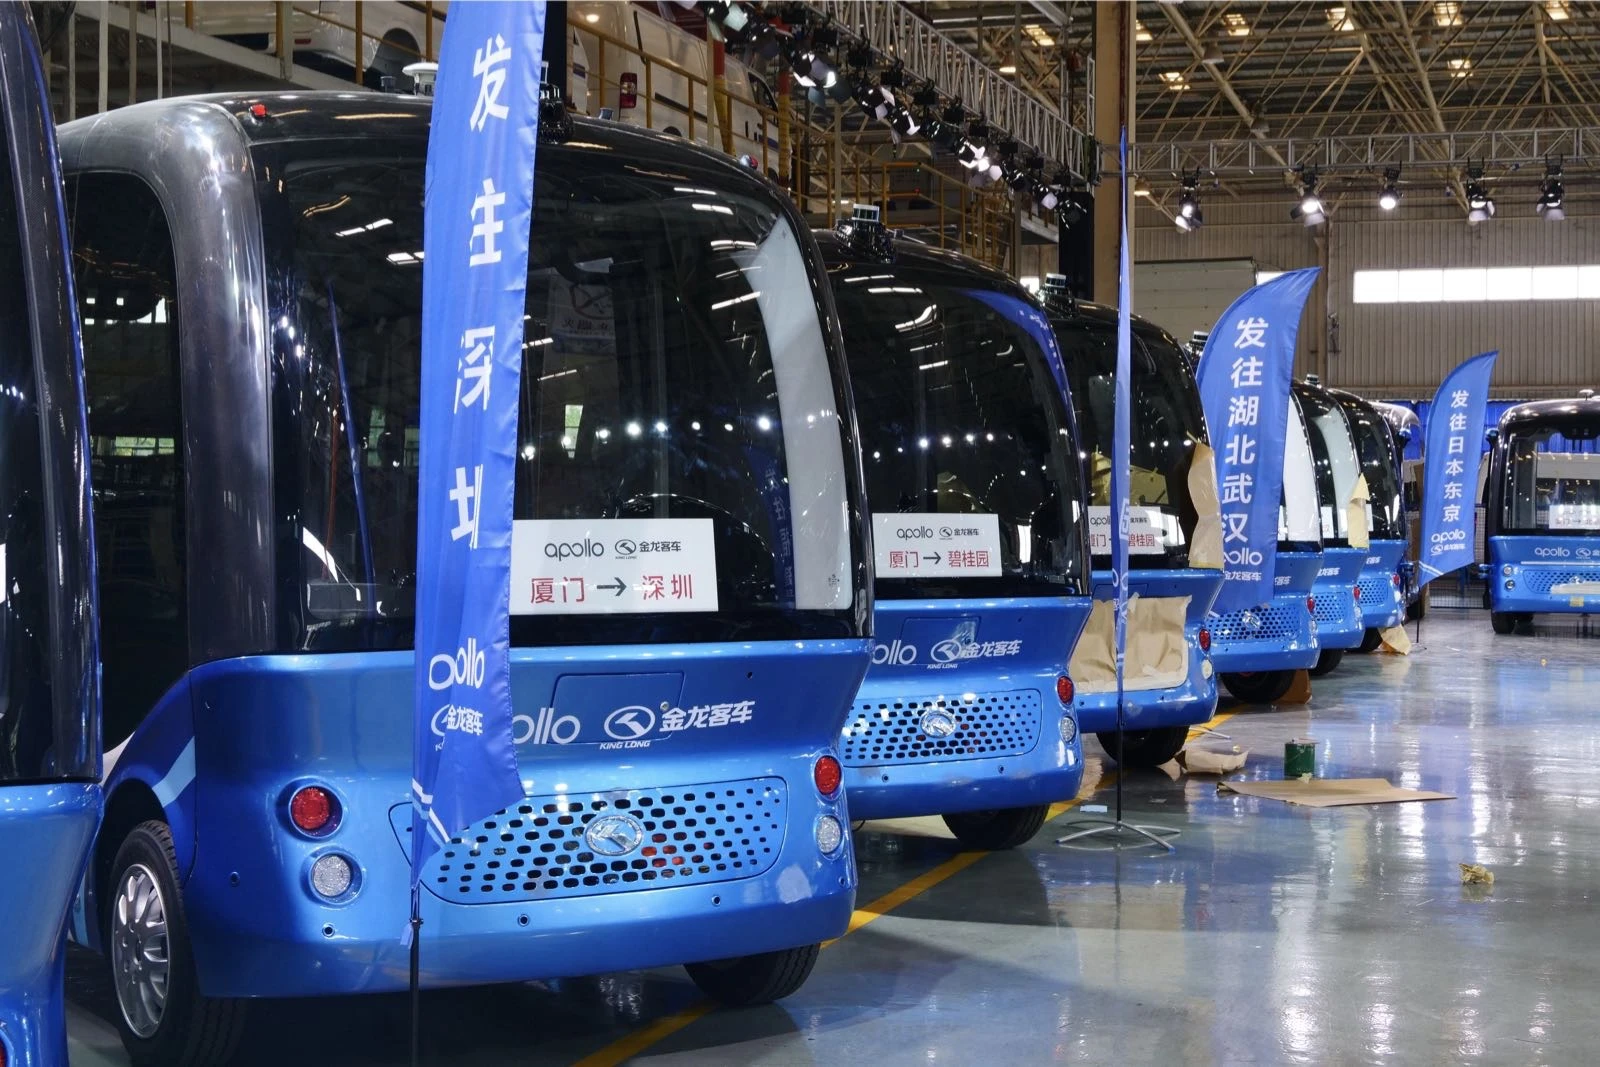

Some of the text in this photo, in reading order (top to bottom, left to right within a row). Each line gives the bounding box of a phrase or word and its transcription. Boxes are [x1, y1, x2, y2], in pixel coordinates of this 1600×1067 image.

[1221, 317, 1269, 543] 发往湖北武汉
[1443, 389, 1469, 522] 发往日本东京
[1090, 515, 1110, 527] apoll
[897, 526, 933, 540] apollo
[1431, 529, 1465, 544] apollo
[544, 538, 604, 561] apollo
[639, 541, 682, 553] 金龙客车
[1224, 548, 1262, 565] ollo
[1534, 547, 1570, 557] apollo
[889, 550, 989, 568] 厦门 碧桂园
[530, 574, 693, 604] 厦门 深圳
[872, 639, 917, 665] ollo
[960, 639, 1023, 659] 金龙客车
[659, 700, 755, 732] 金龙客车
[512, 707, 581, 745] ollo
[600, 740, 650, 750] KING LONG
